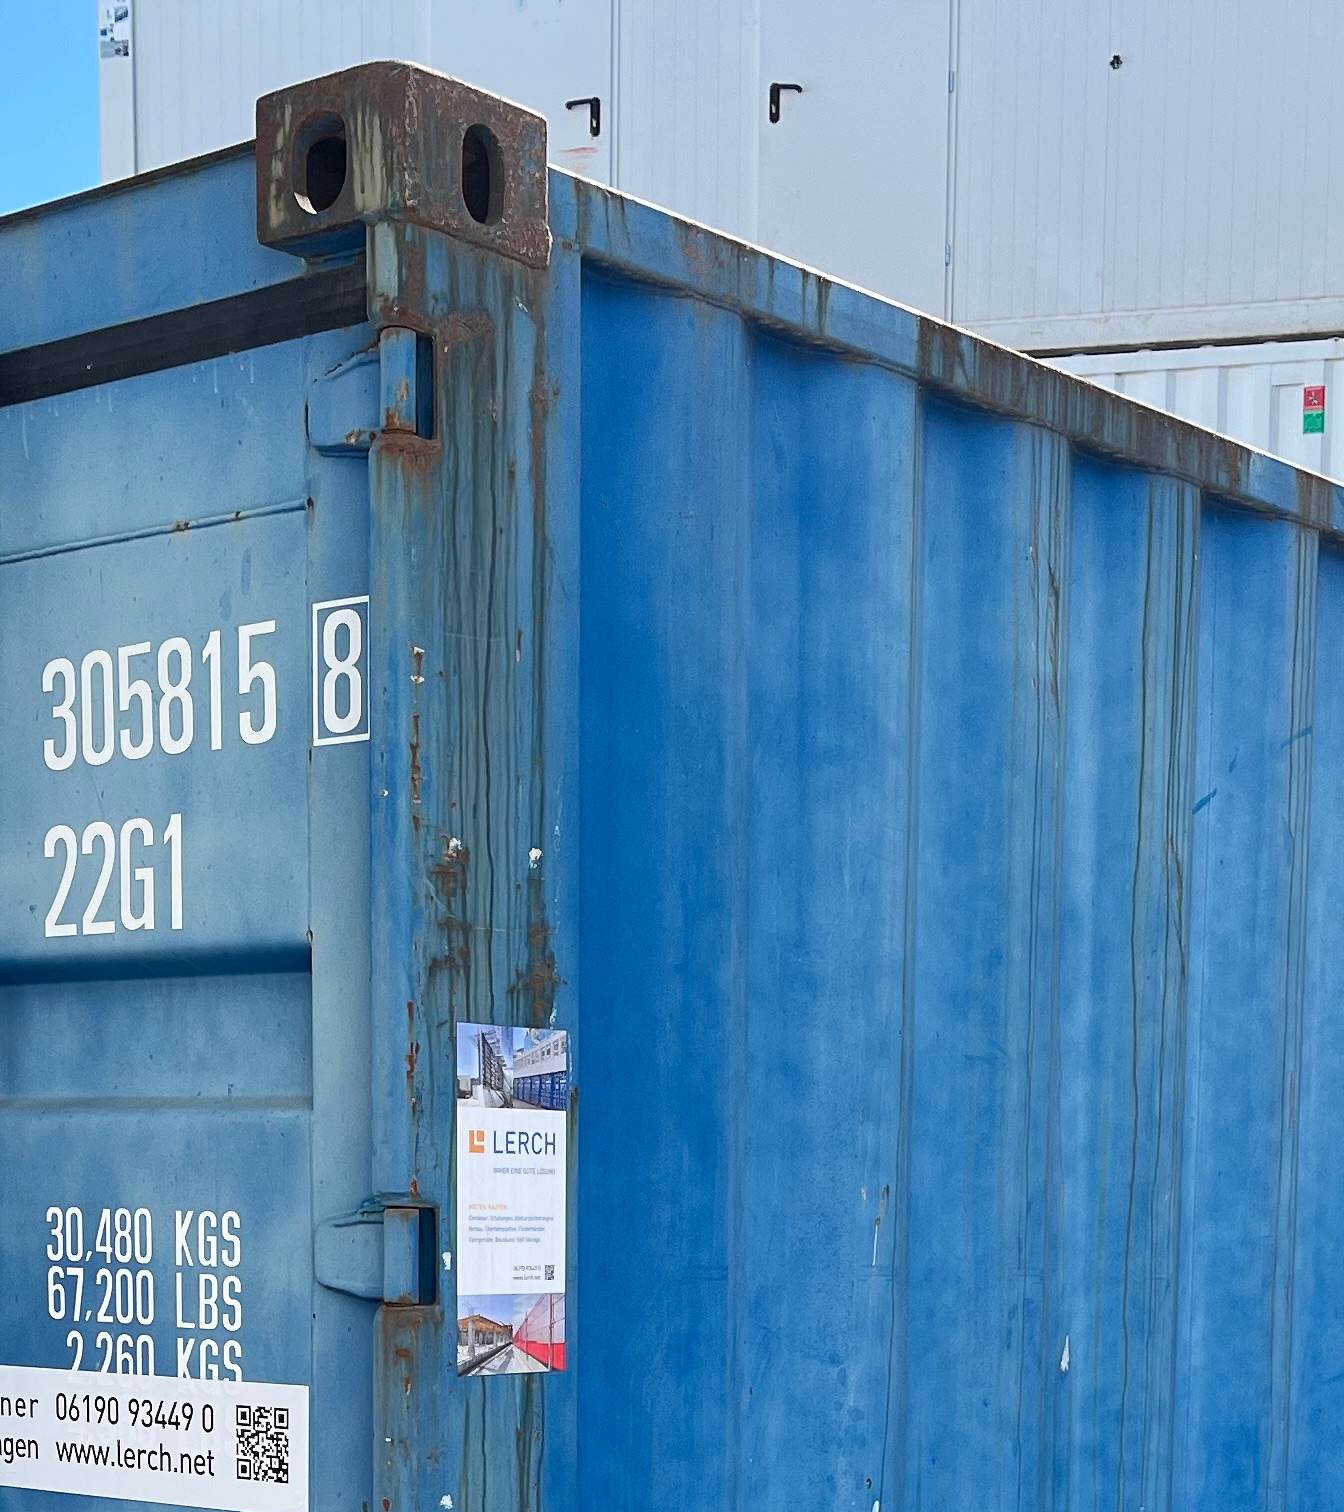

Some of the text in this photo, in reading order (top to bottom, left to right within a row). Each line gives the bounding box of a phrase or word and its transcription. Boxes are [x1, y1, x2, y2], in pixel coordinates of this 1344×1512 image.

[43, 607, 362, 771] 305815 8
[45, 814, 183, 938] 22G1
[493, 1130, 556, 1156] LERCH
[47, 1206, 242, 1268] 30,480 KGS
[48, 1266, 242, 1332] 67,200 LBS
[67, 1330, 242, 1382] 2260 KGS
[56, 1392, 119, 1425] 06190
[128, 1398, 194, 1431] 93449
[202, 1403, 214, 1433] 0
[55, 1439, 215, 1477] www.lerch.net
